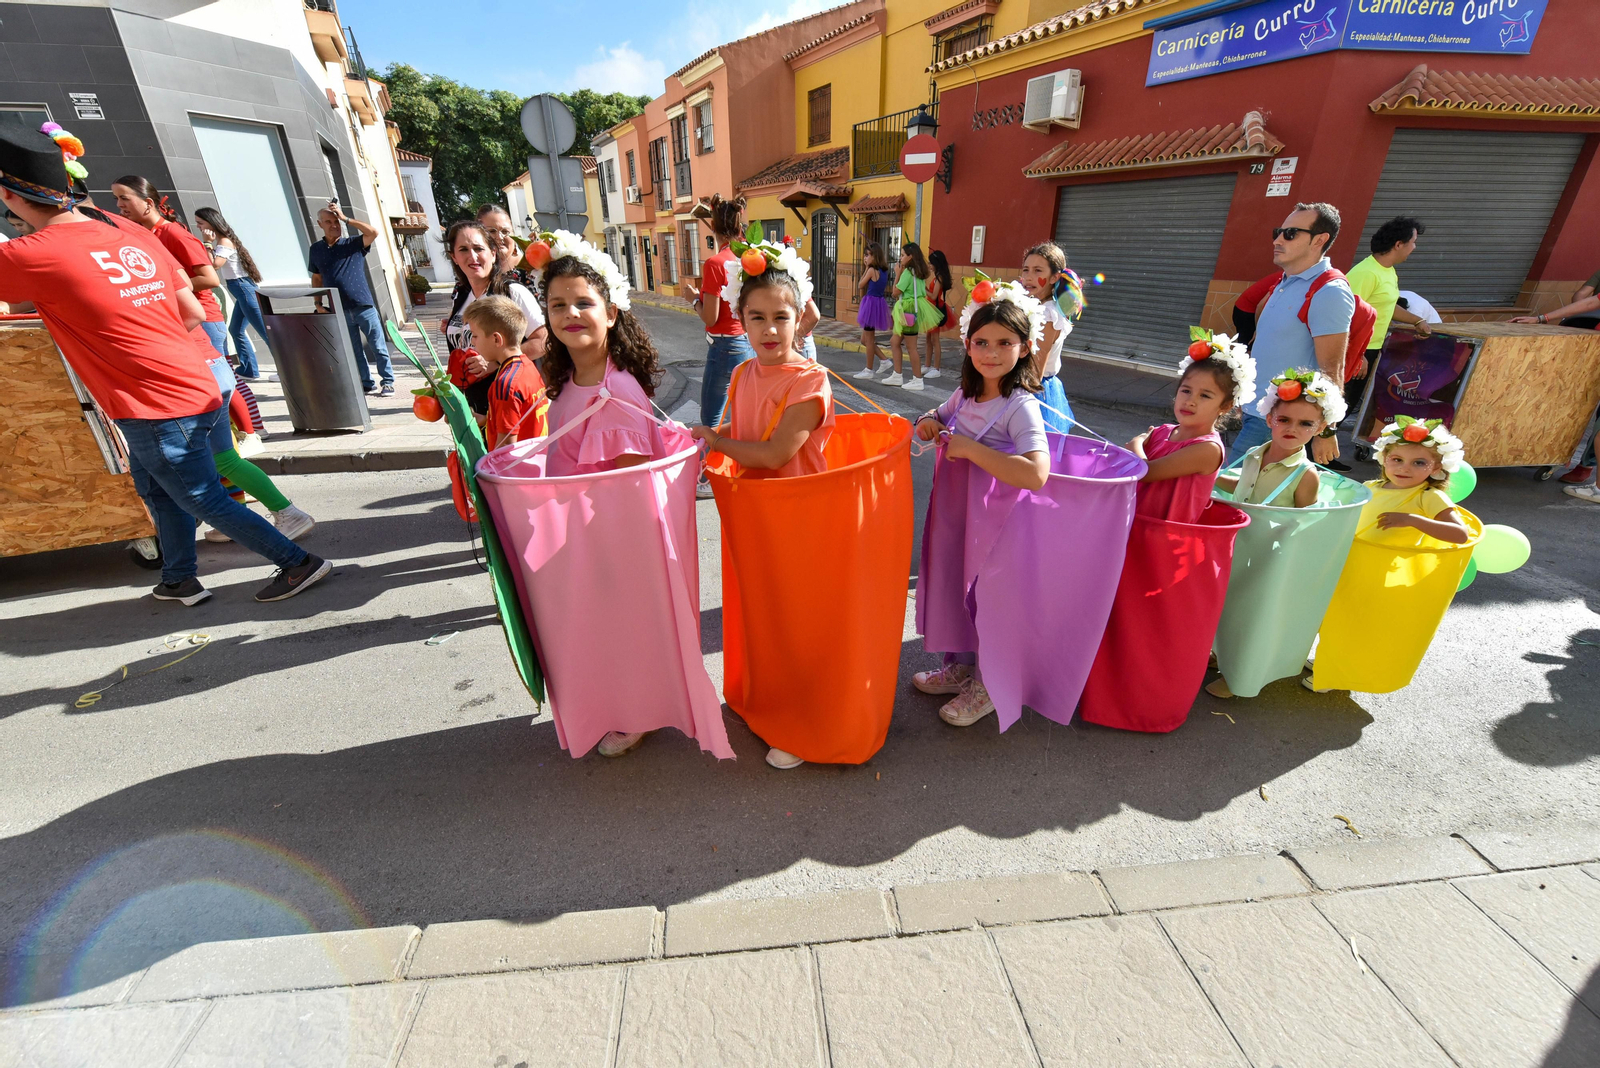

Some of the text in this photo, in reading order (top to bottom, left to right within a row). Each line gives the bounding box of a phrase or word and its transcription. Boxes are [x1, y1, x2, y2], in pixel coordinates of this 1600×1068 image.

[1157, 0, 1315, 57] Carnicería Curro
[1428, 33, 1471, 44] Chicharrones
[1222, 50, 1267, 64] Chicharrones
[1250, 163, 1264, 174] 79
[119, 280, 165, 298] ANIVERSARIO
